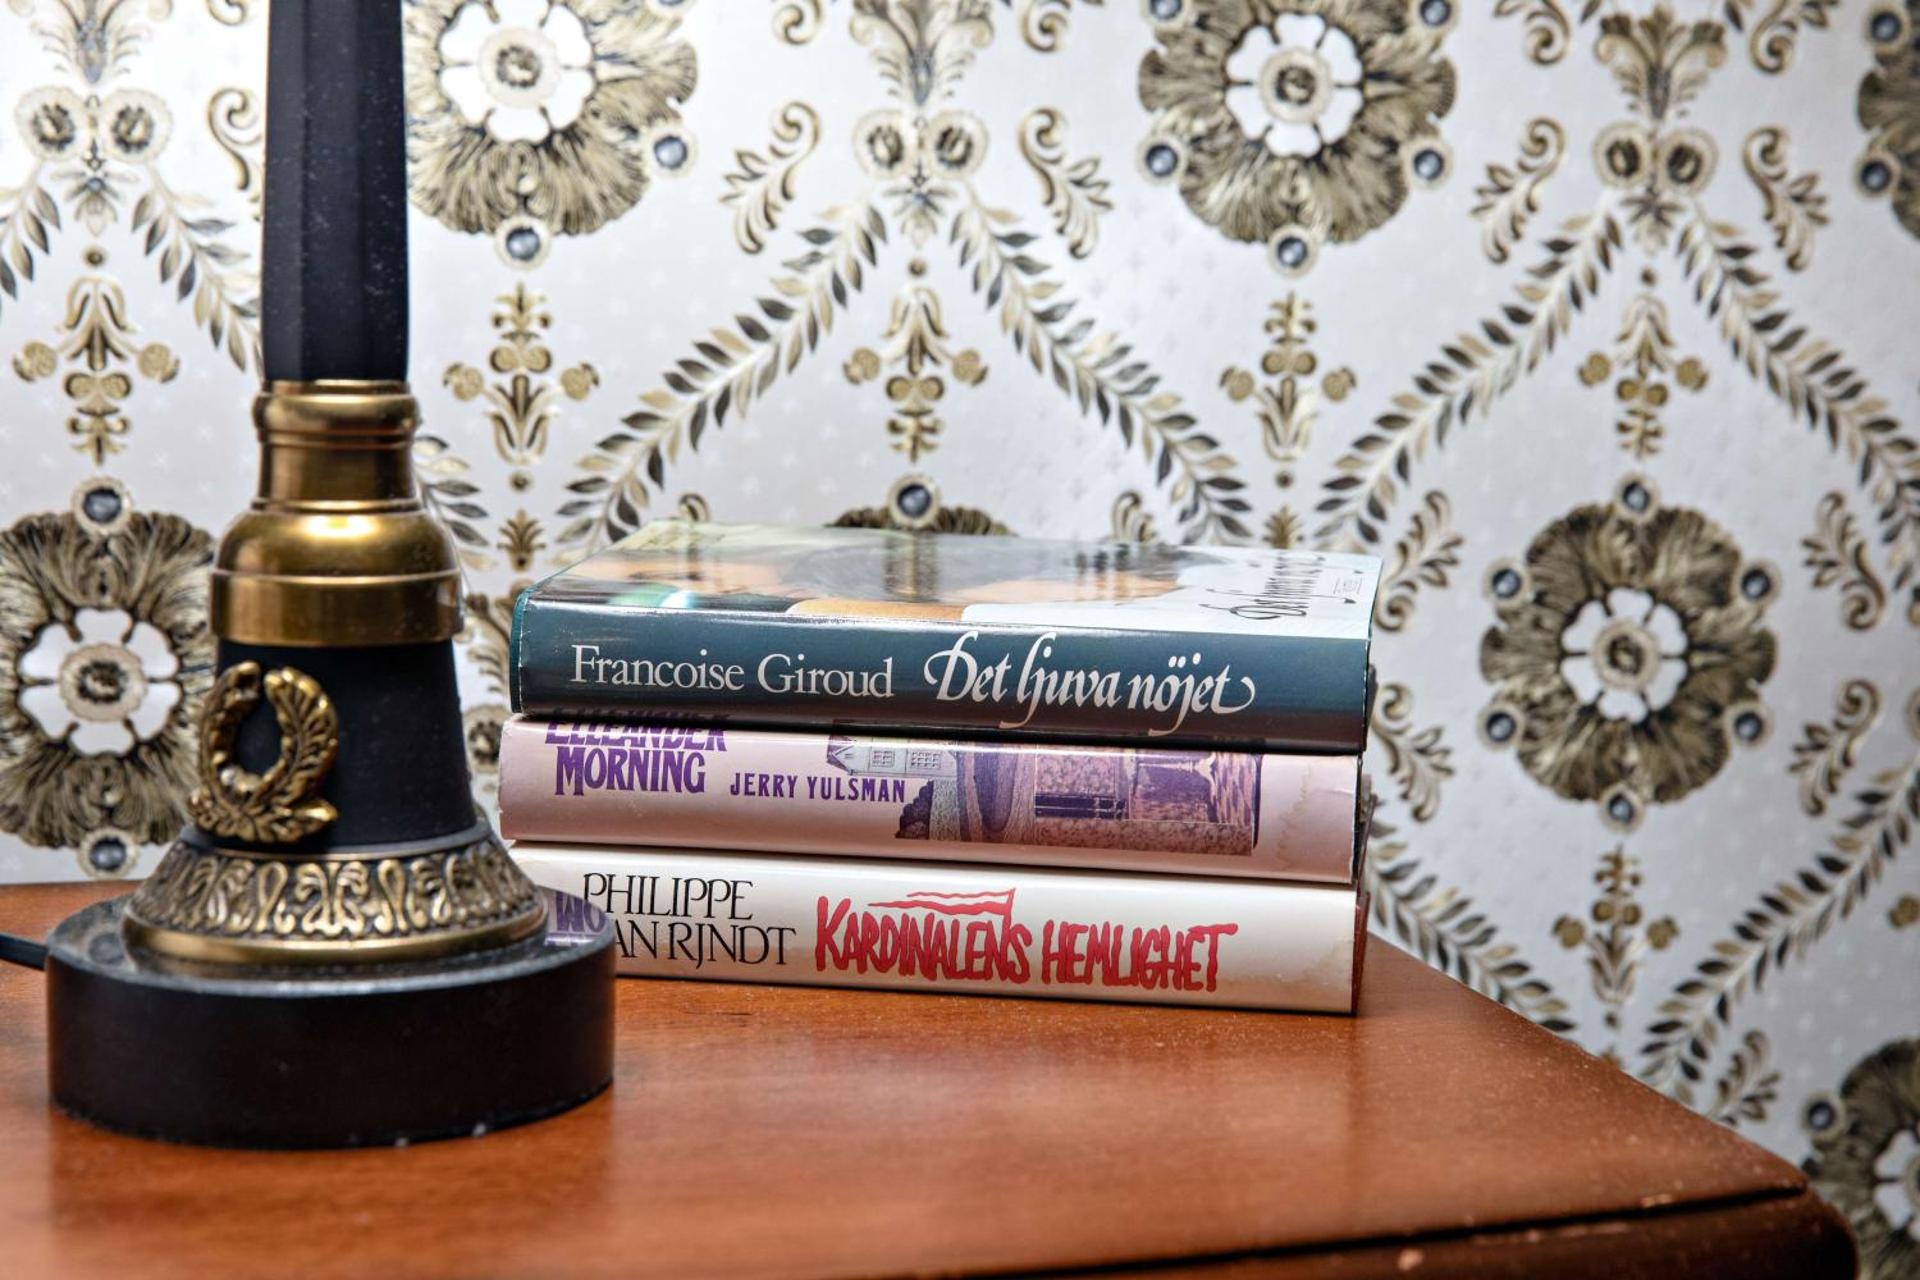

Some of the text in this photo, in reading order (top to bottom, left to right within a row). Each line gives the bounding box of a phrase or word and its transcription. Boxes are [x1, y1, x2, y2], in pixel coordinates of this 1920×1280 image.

[570, 644, 895, 698] Francoise Giroud
[924, 631, 1255, 737] Det ljuva nöjet
[554, 746, 706, 796] MORNING
[730, 773, 906, 803] JERRY YULSMAN
[584, 873, 753, 920] PHILIPPE
[614, 918, 797, 969] AN RJNDT
[815, 888, 1239, 992] KARDINALENS HEMLIGHET
